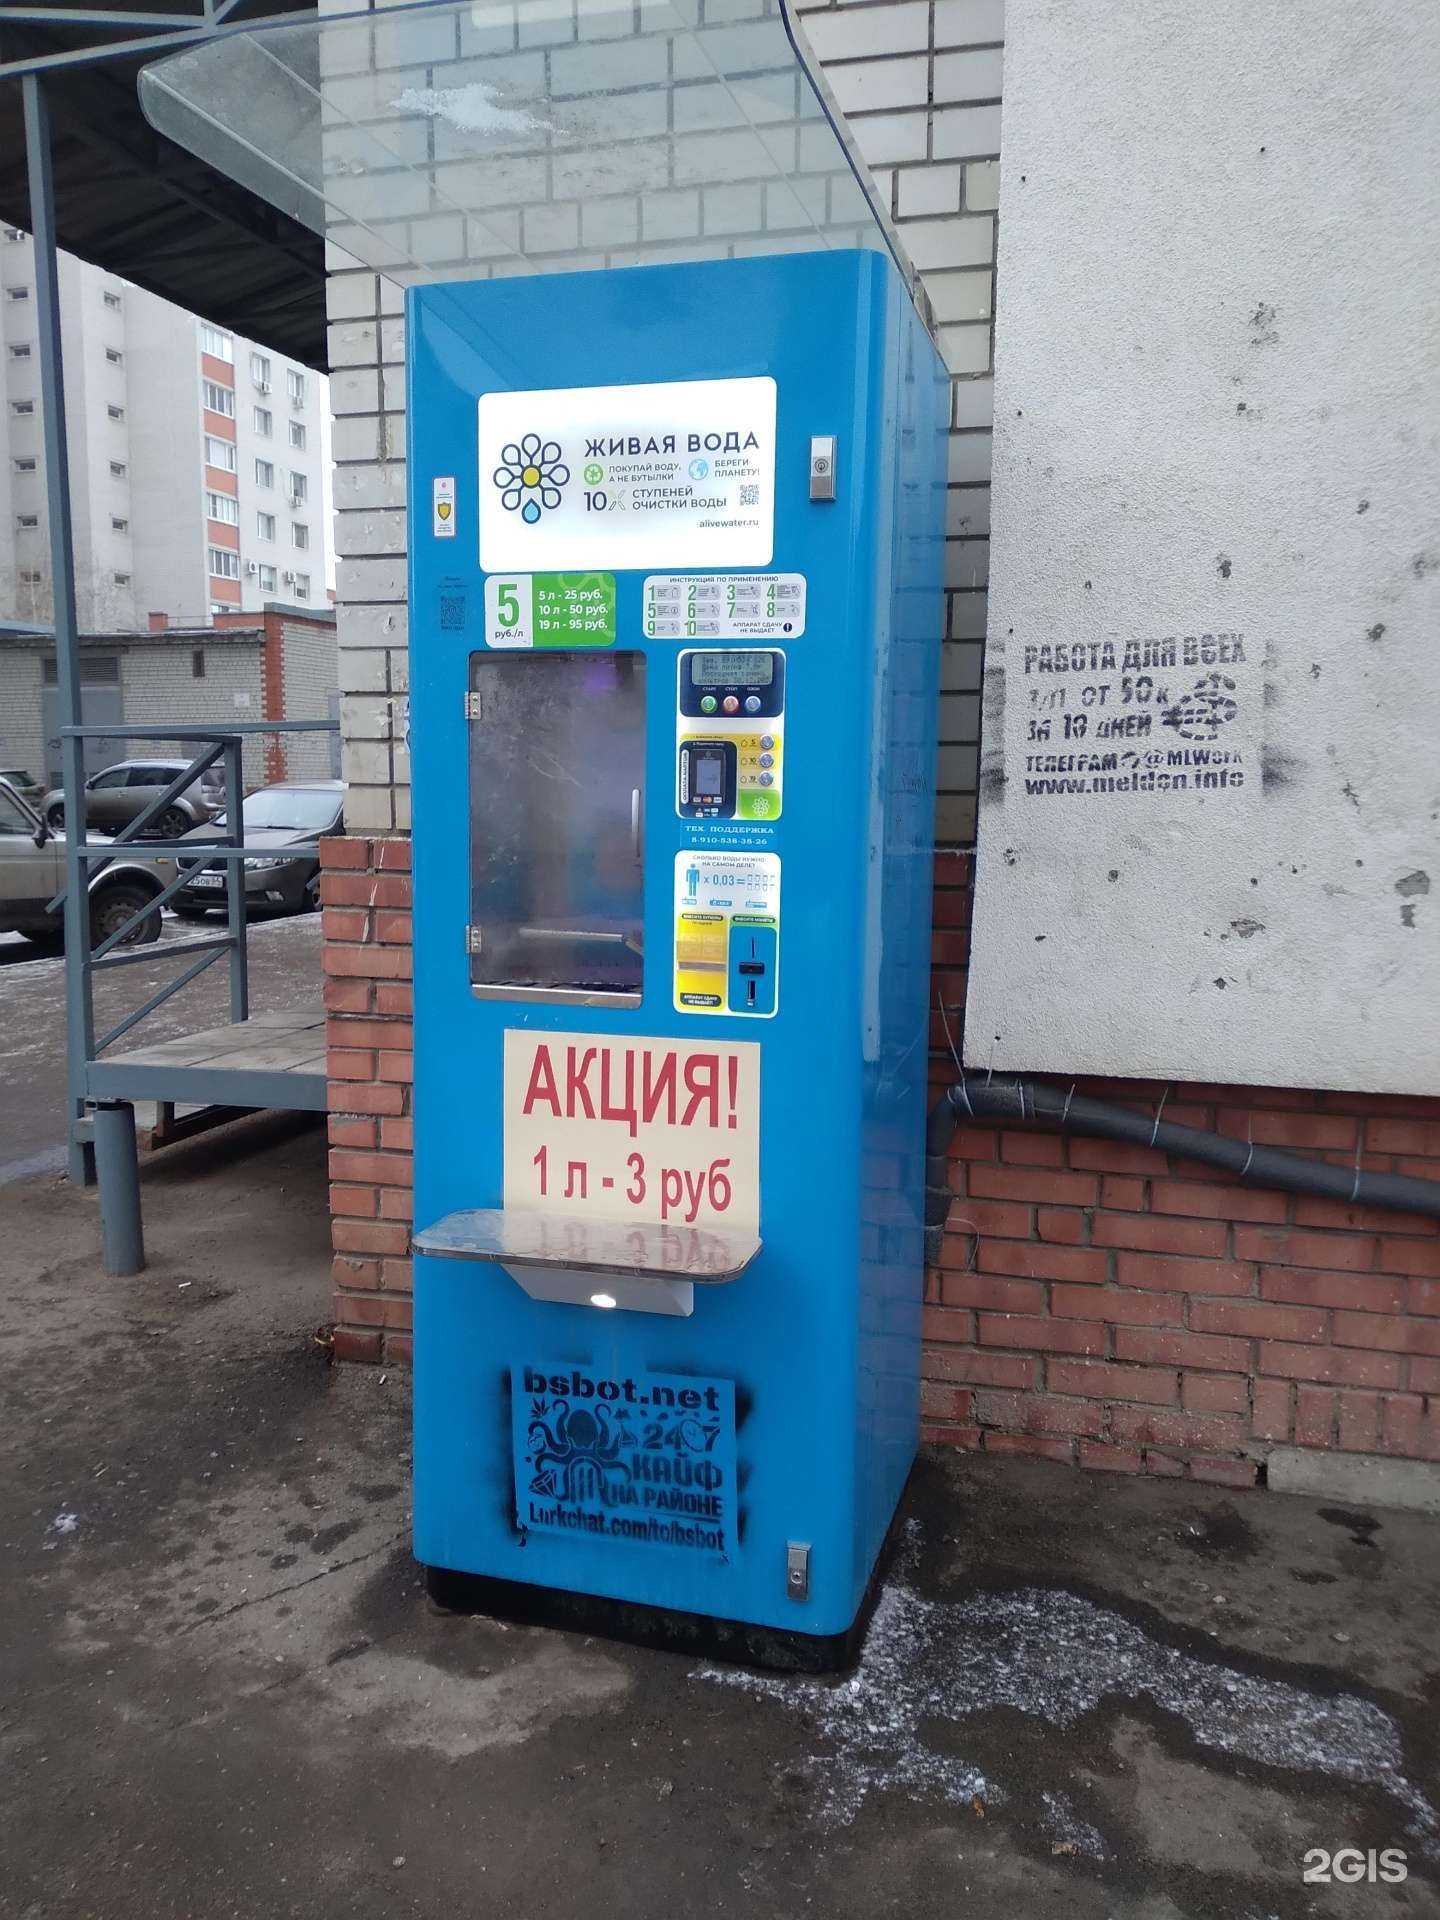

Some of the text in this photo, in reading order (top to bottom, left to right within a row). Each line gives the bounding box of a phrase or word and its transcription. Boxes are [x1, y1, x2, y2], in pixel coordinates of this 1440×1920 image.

[584, 431, 760, 458] ЖИВАЯ ВОДА
[609, 463, 652, 473] ПОКУПАЙ
[714, 458, 749, 467] БЕРЕГИ
[631, 473, 674, 482] БУТЫЛКИ
[714, 468, 760, 478] ПЛАНЕТУ!
[632, 486, 693, 498] СТУПЕНЕЙ
[632, 498, 727, 511] ОЧИСТКИ ВОДЫ
[699, 519, 759, 528] alivewater.ru
[539, 591, 545, 600] 5
[548, 592, 555, 600] л
[564, 590, 577, 600] 25
[579, 589, 603, 601] руб.
[648, 585, 655, 600] 1
[688, 585, 697, 600] 2
[727, 584, 736, 600] 3
[767, 584, 776, 600] 4
[497, 584, 520, 627] 5
[539, 605, 551, 615] 10
[552, 606, 560, 615] л
[569, 604, 583, 614] 50
[585, 603, 608, 615] руб.
[648, 603, 656, 618] 5
[688, 602, 696, 618] 6
[727, 602, 736, 618] 7
[767, 602, 775, 617] 8
[539, 619, 551, 630] 19
[552, 621, 560, 630] л
[569, 619, 582, 629] 95
[584, 618, 608, 630] руб.
[648, 621, 655, 636] 9
[684, 620, 696, 636] 10
[494, 629, 524, 639] руб./л
[1025, 633, 1246, 673] РАБОТА ДЛЯ ВСЕХ
[1081, 685, 1111, 707] ОТ
[1026, 753, 1118, 772] ТЕЛЕГРАМ
[710, 825, 774, 834] ПОДДЕРЖКА
[522, 1044, 738, 1137] АКЦИЯ!
[533, 1145, 547, 1195] 1
[564, 1161, 587, 1199] л
[626, 1152, 646, 1204] 3
[661, 1158, 732, 1222] руб
[524, 1368, 720, 1411] bsbot.net
[632, 1452, 723, 1490] КАЙФ
[644, 1488, 723, 1517] РАЙОНЕ
